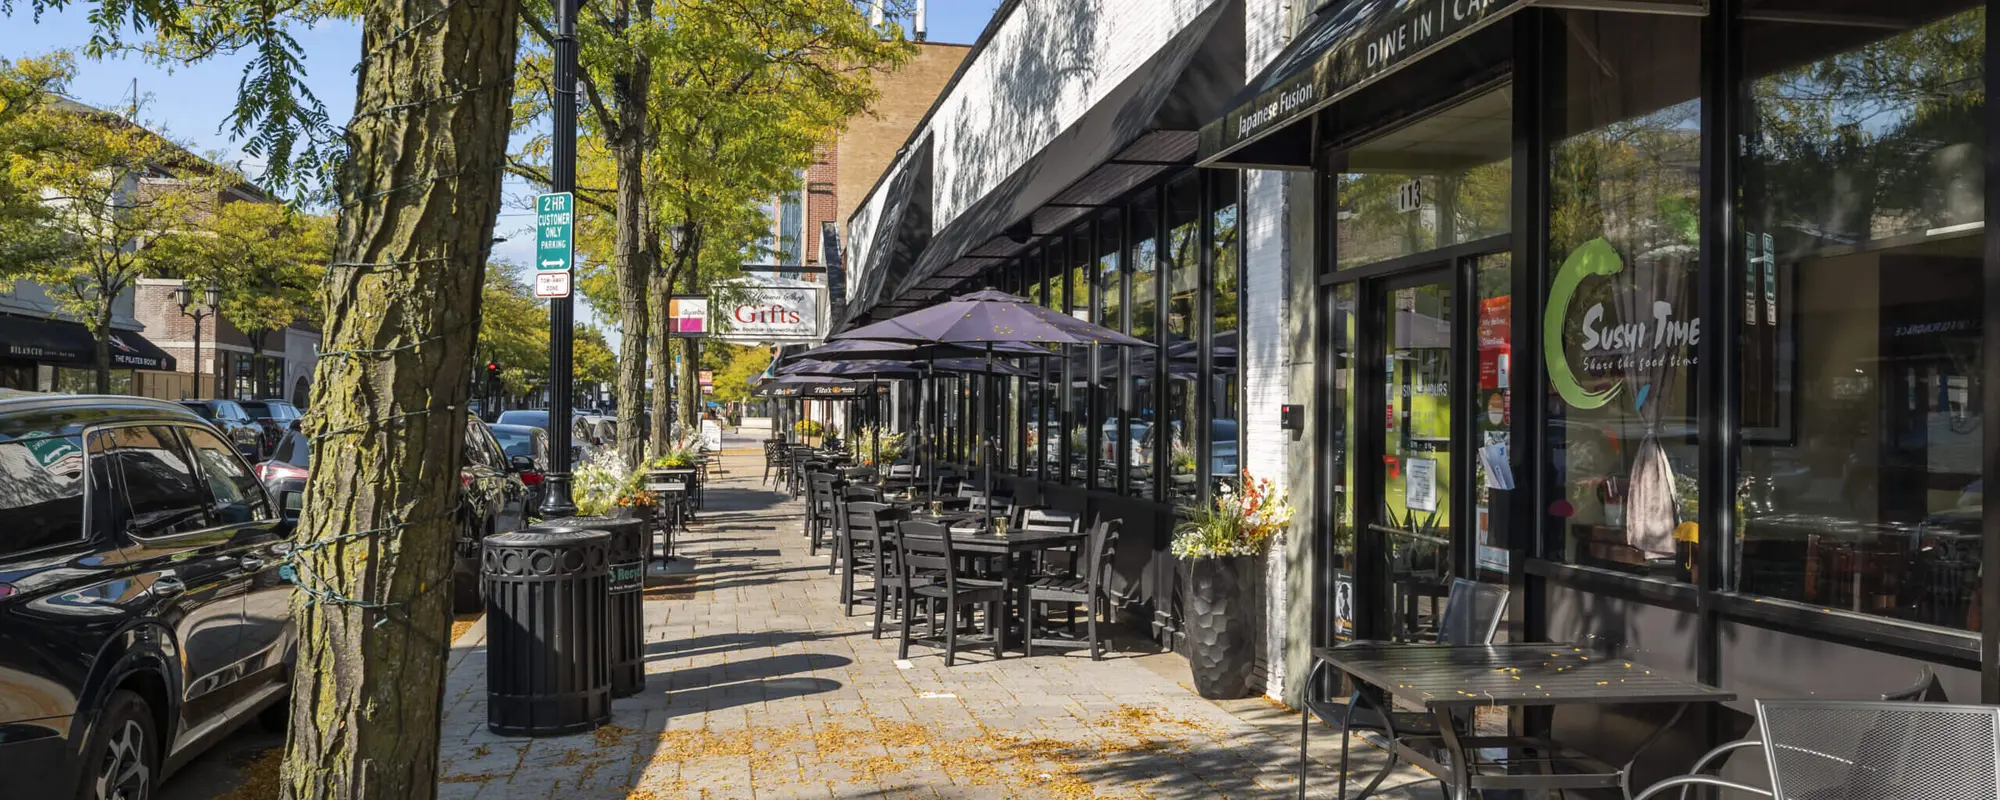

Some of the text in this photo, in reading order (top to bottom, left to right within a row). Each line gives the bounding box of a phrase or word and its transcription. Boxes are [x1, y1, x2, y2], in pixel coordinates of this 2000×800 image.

[1367, 0, 1495, 68] DINE IN CA
[1238, 83, 1312, 139] Japanese Fusion
[544, 195, 565, 211] 2 HR
[1400, 180, 1421, 210] 113
[538, 213, 570, 226] CUSTOMER
[545, 226, 562, 238] ONLY
[541, 240, 566, 250] PARKING
[734, 304, 800, 324] Gifts
[115, 354, 157, 366] THE PILATES ROOM
[1583, 356, 1614, 371] Share
[1618, 356, 1635, 370] the
[1670, 354, 1699, 367] time
